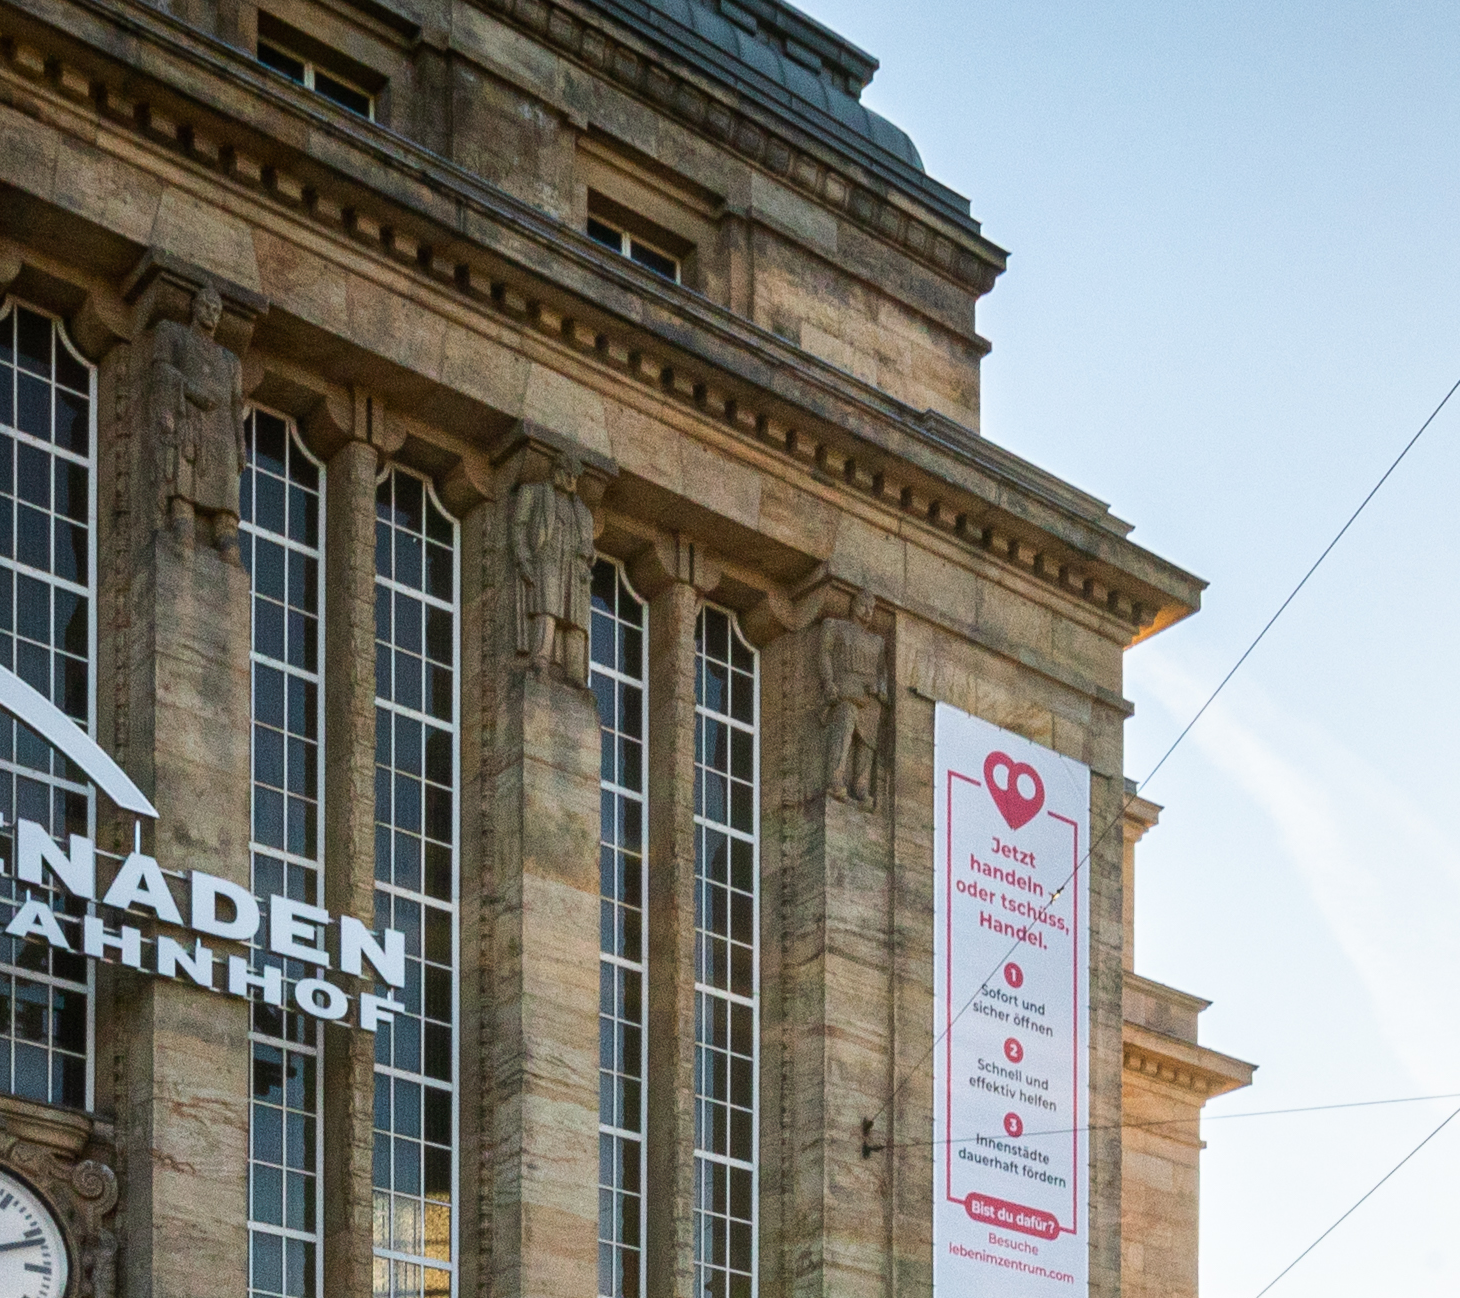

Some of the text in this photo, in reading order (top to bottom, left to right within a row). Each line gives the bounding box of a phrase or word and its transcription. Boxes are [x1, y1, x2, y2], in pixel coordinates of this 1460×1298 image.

[991, 836, 1036, 868] Jetzt
[970, 853, 1044, 897] handeln
[956, 880, 1069, 936] oder tschüss,
[980, 911, 1047, 950] Handel.
[982, 984, 1045, 1015] Sofort und
[973, 1001, 1053, 1037] sicher öffnen
[978, 1058, 1049, 1090] Schnell und
[969, 1076, 1057, 1112] effektiv helfen
[976, 1134, 1050, 1164] Innenstädte
[958, 1147, 1067, 1188] dauerhaft fördern
[971, 1201, 1055, 1233] Bist du dafür?
[989, 1232, 1039, 1255] Besuche
[949, 1242, 1075, 1284] lebenimzentrum.com
